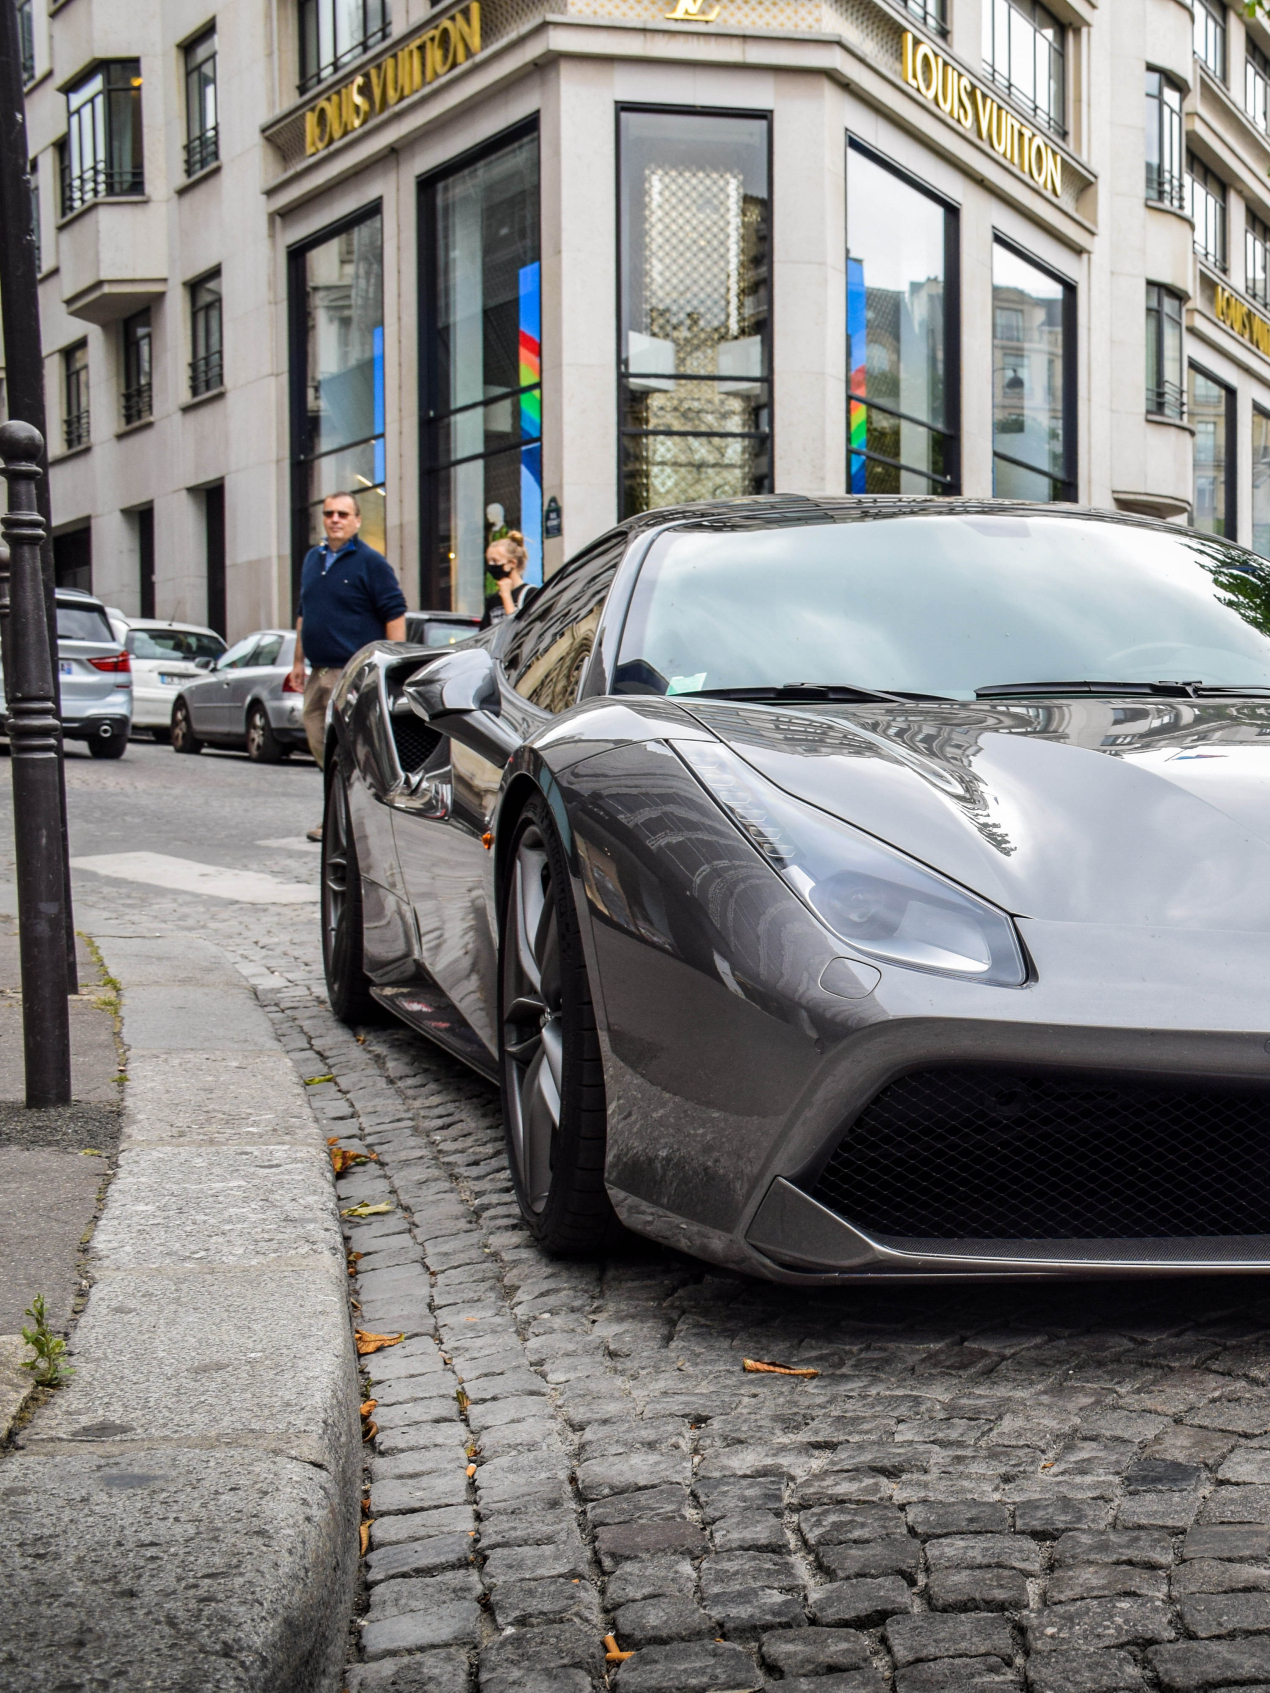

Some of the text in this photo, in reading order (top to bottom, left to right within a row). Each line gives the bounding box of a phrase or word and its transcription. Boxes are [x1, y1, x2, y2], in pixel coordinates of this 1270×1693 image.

[305, 1, 481, 157] LOUIS VUITTON
[902, 31, 1062, 198] LOUIS VUITTON
[1215, 284, 1250, 342] LOUIS
